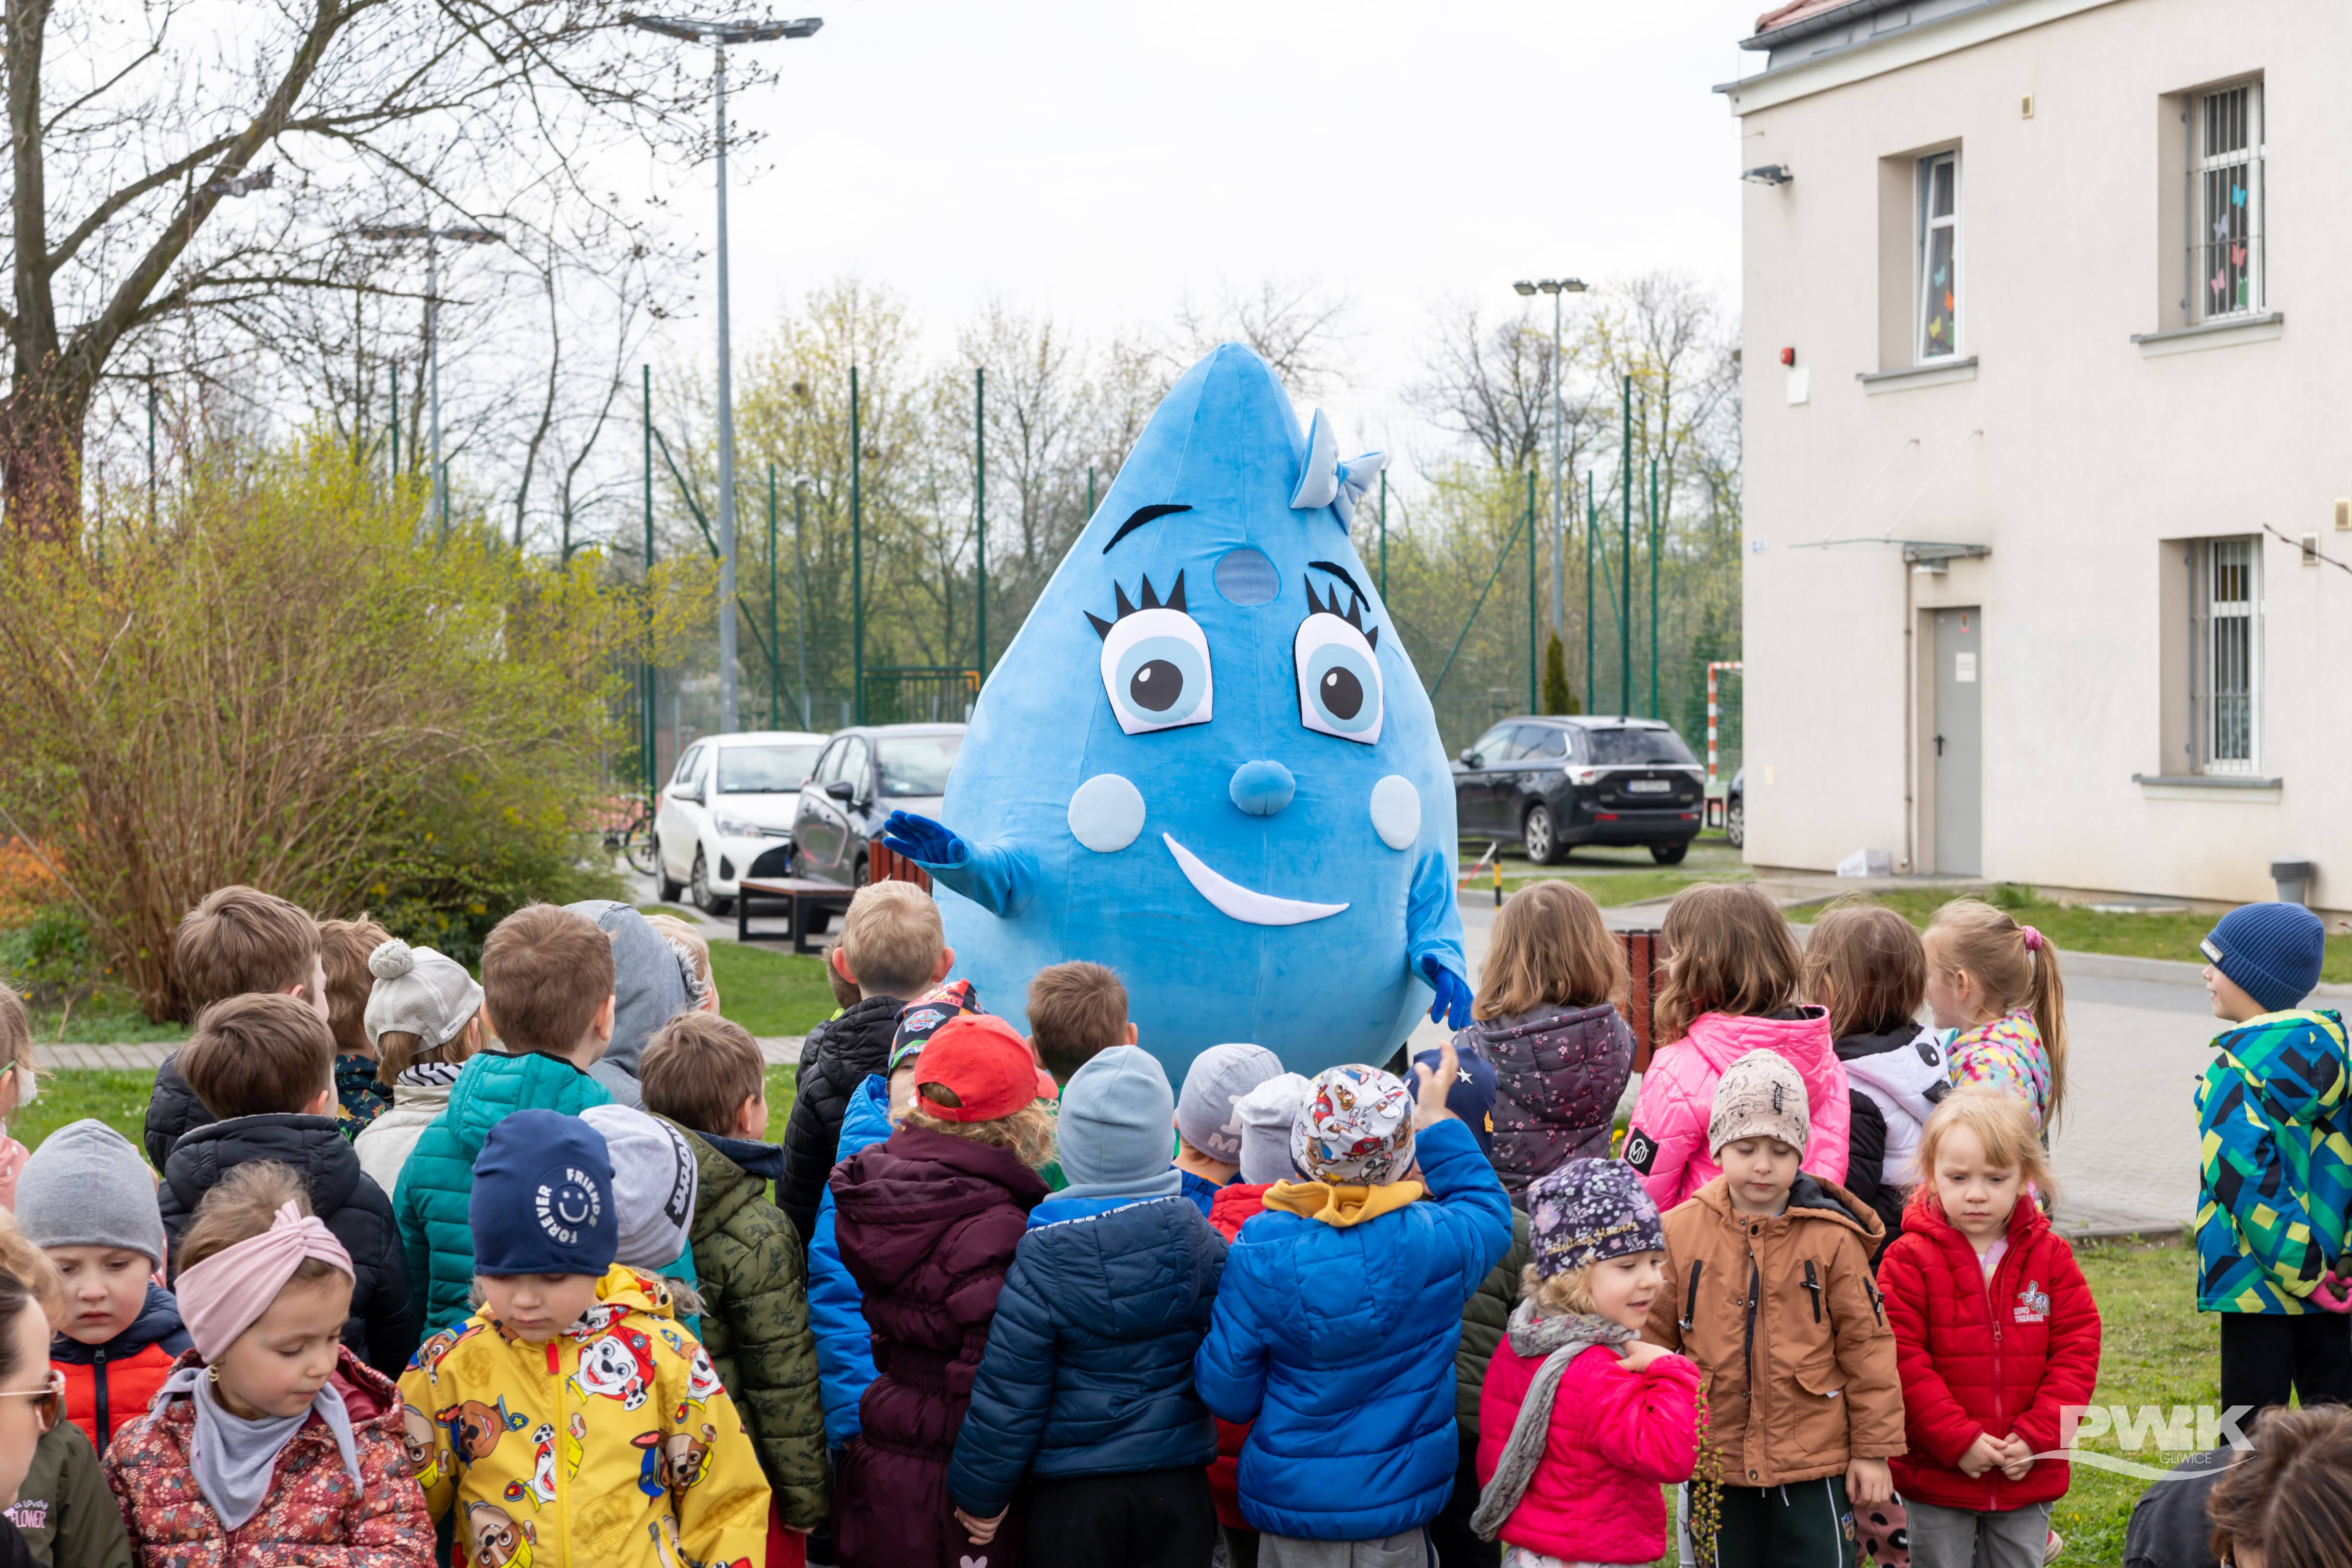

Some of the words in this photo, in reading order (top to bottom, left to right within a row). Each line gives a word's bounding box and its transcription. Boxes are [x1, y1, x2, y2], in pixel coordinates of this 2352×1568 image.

[535, 1185, 577, 1244] FOREVER
[566, 1168, 601, 1228] FRIENDS
[11, 1509, 47, 1529] FLOWER
